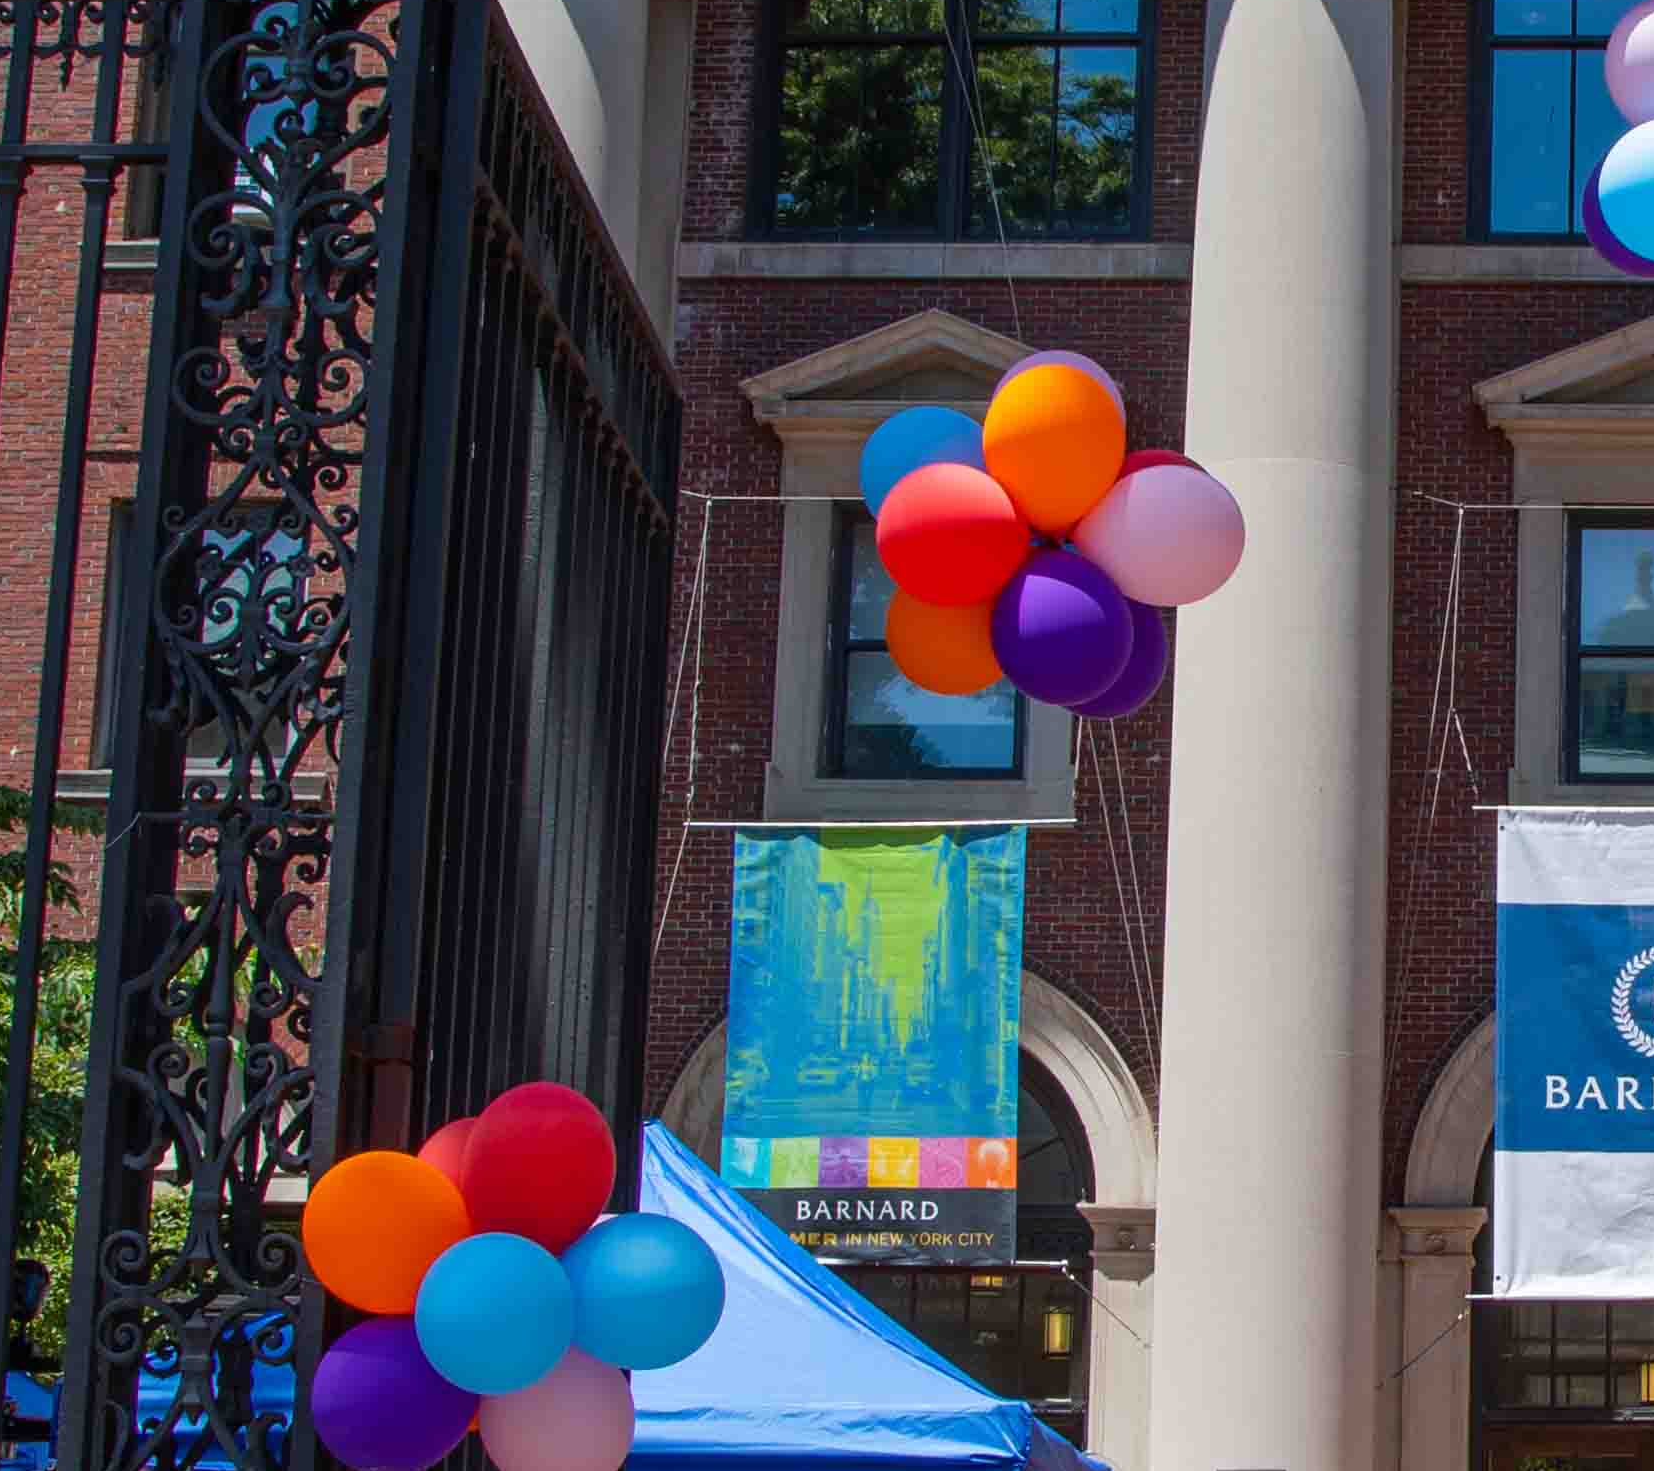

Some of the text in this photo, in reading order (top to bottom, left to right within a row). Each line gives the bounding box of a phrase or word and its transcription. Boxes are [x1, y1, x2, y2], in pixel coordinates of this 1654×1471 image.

[795, 1199, 939, 1221] BARNARD
[789, 1233, 995, 1247] MER IN NEW YORK CITY
